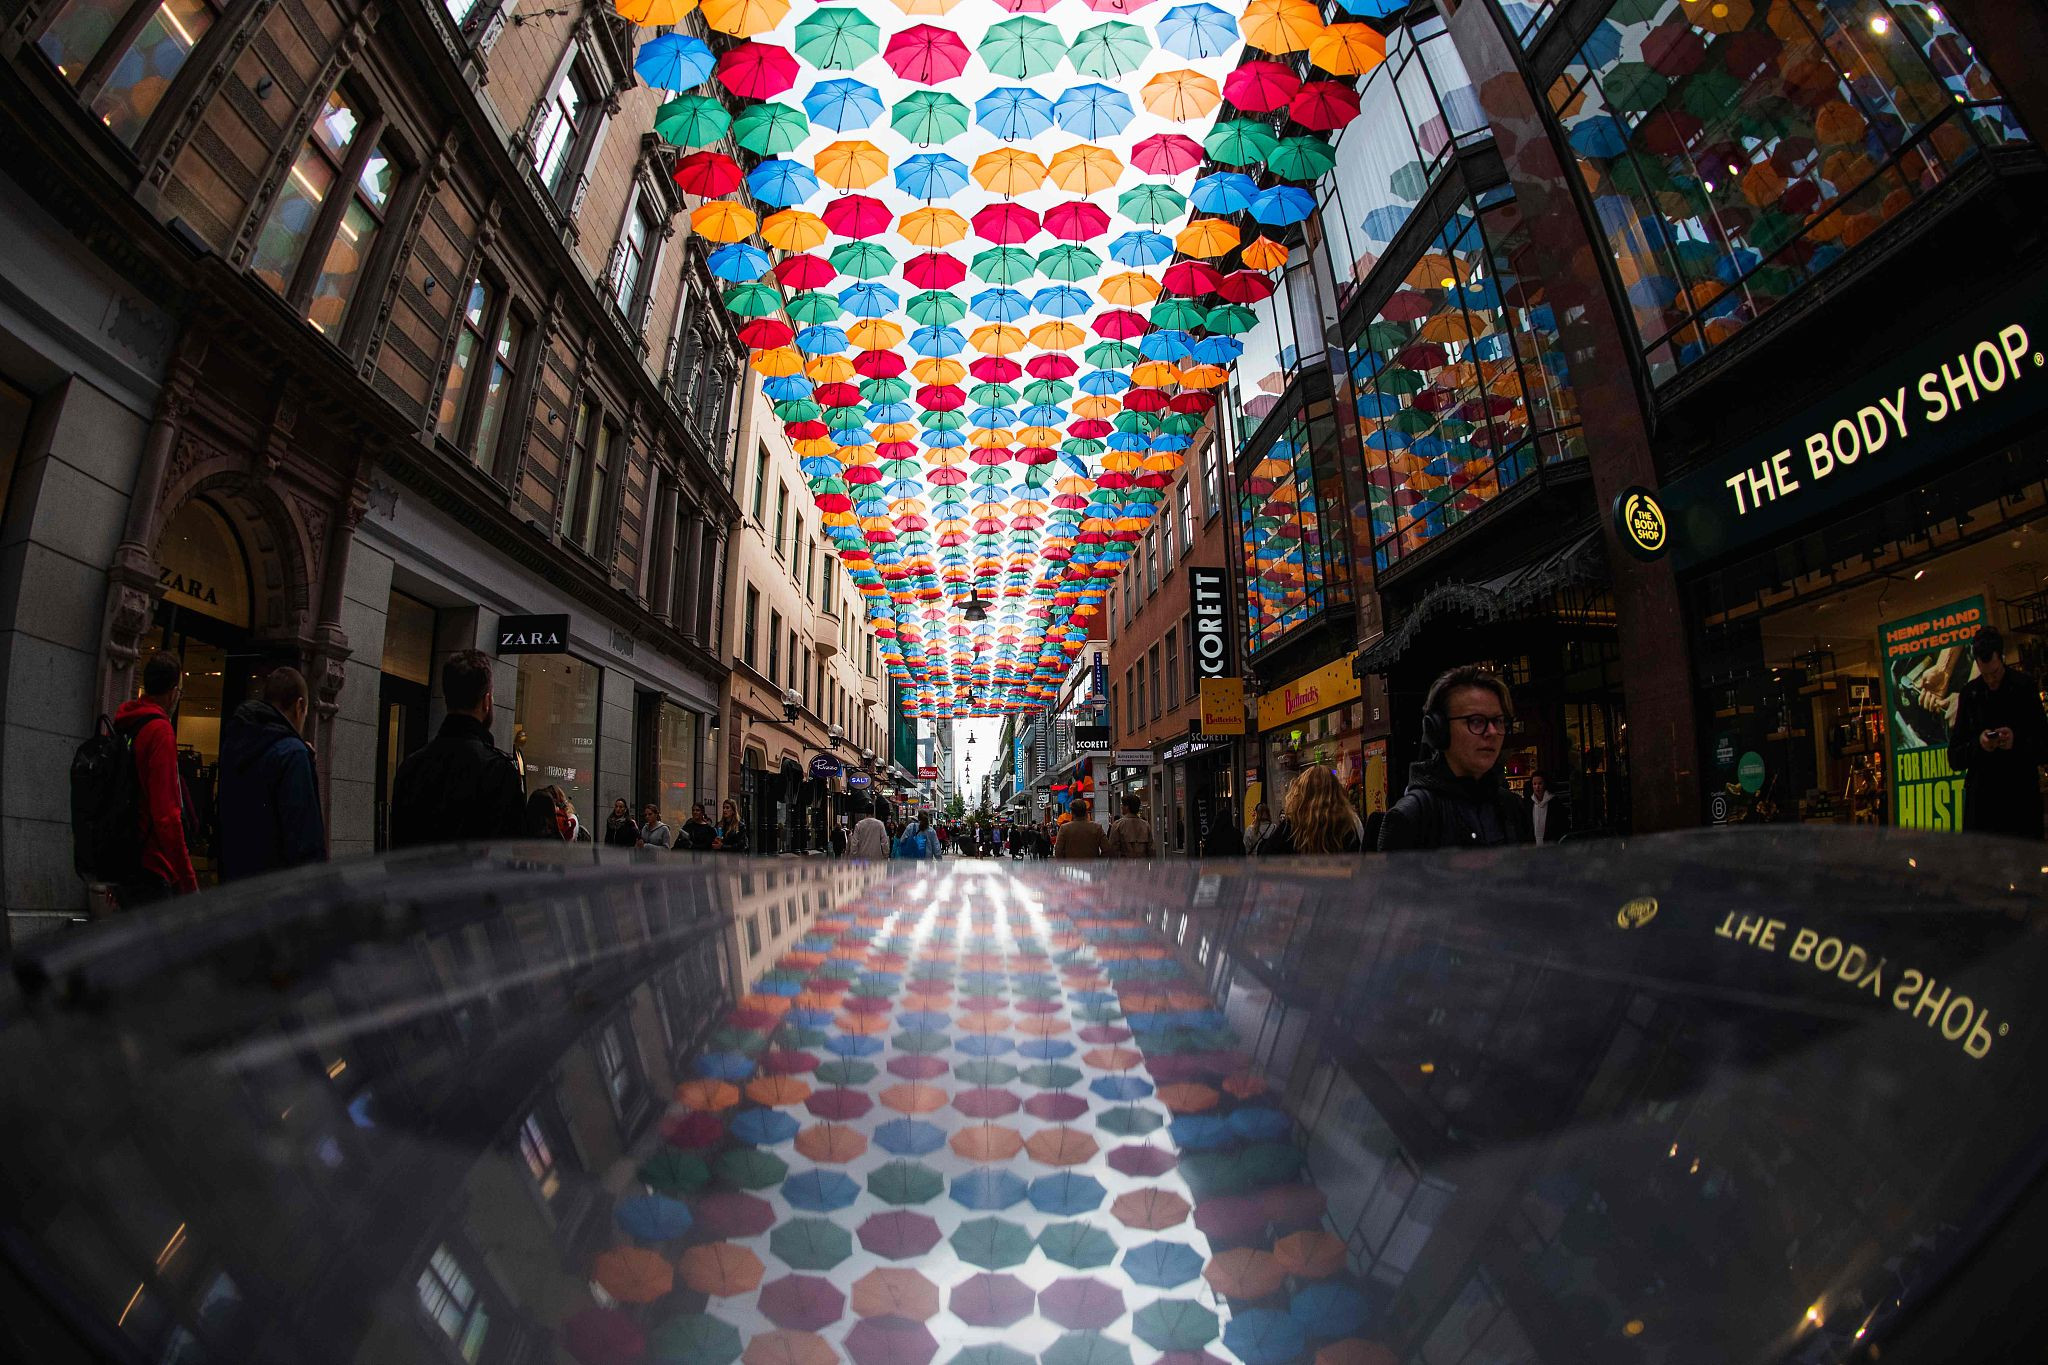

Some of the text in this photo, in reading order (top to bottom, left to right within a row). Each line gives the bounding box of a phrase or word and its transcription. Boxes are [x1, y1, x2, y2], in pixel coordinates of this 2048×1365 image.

[1725, 448, 1800, 516] THE
[1805, 386, 1908, 480] BODY
[1634, 518, 1658, 530] BODY
[1637, 510, 1652, 520] THE
[1638, 529, 1660, 540] SHOP
[159, 566, 218, 606] ZARA
[1196, 573, 1224, 678] CORETT
[1886, 608, 1980, 643] HEMP HAND
[501, 632, 560, 645] ZARA
[1076, 740, 1108, 749] SCORETT
[1897, 752, 1920, 782] FOR
